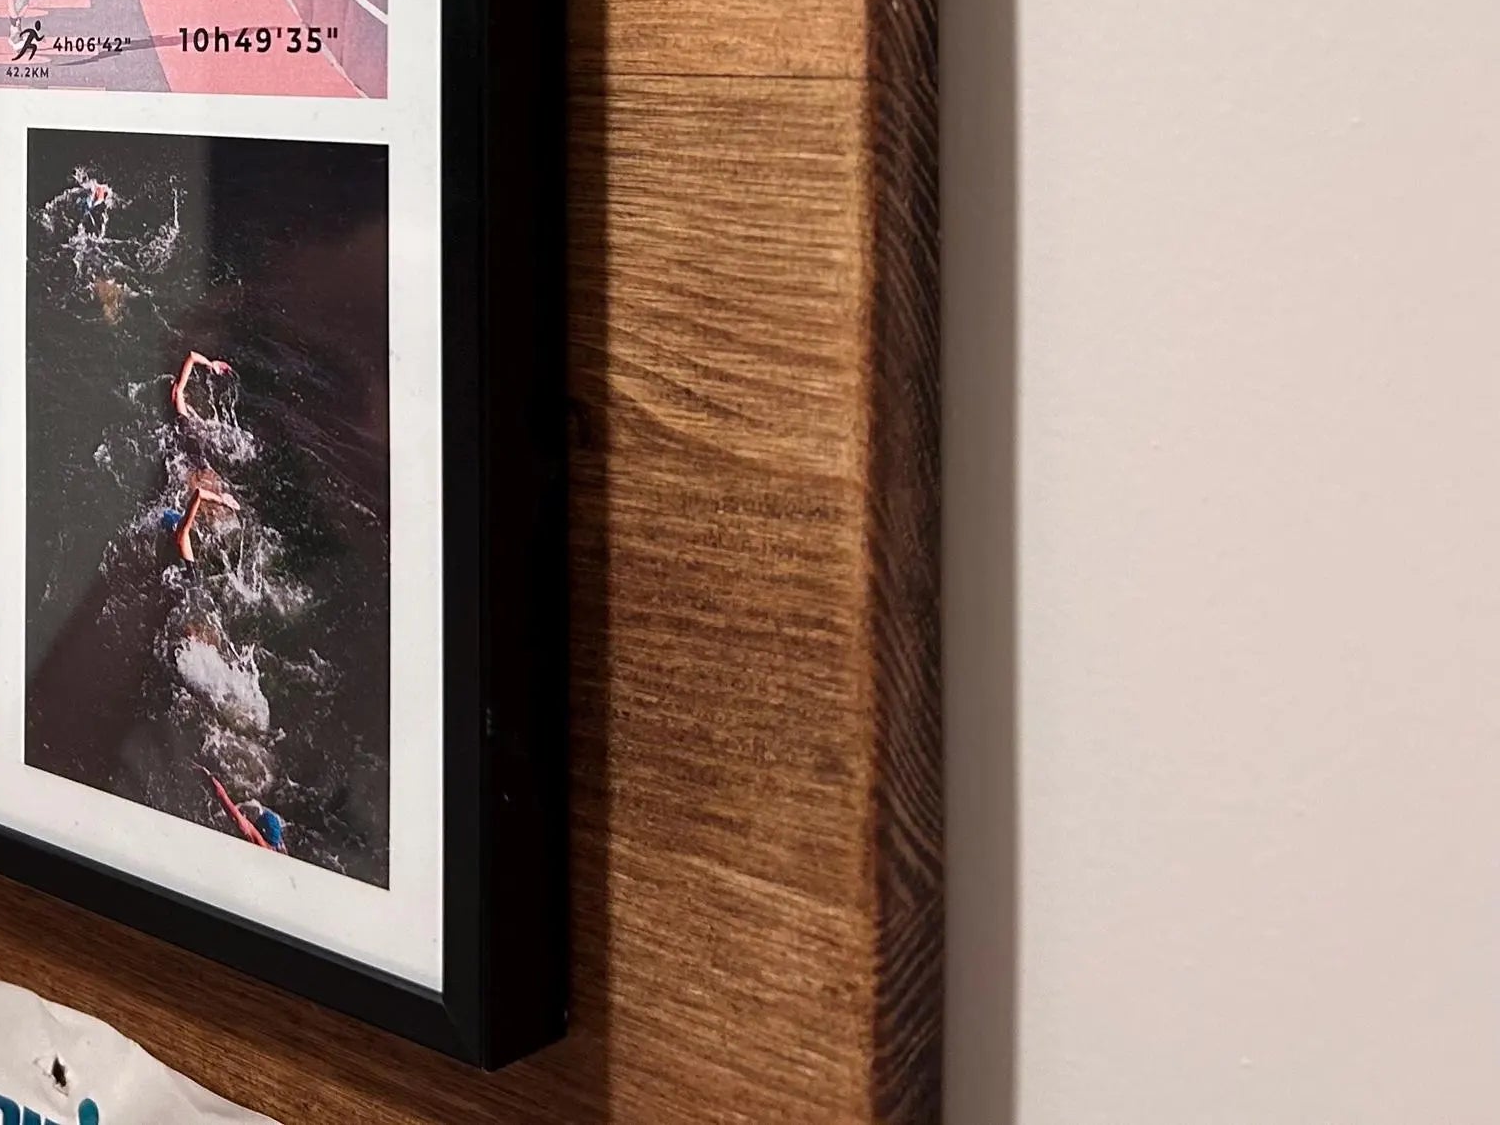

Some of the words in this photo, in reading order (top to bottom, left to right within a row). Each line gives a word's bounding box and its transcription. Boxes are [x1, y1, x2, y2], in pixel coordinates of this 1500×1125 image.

[52, 36, 132, 53] 4h06'42"
[179, 27, 339, 54] 10h49'35"
[6, 65, 49, 78] 42.2KM
